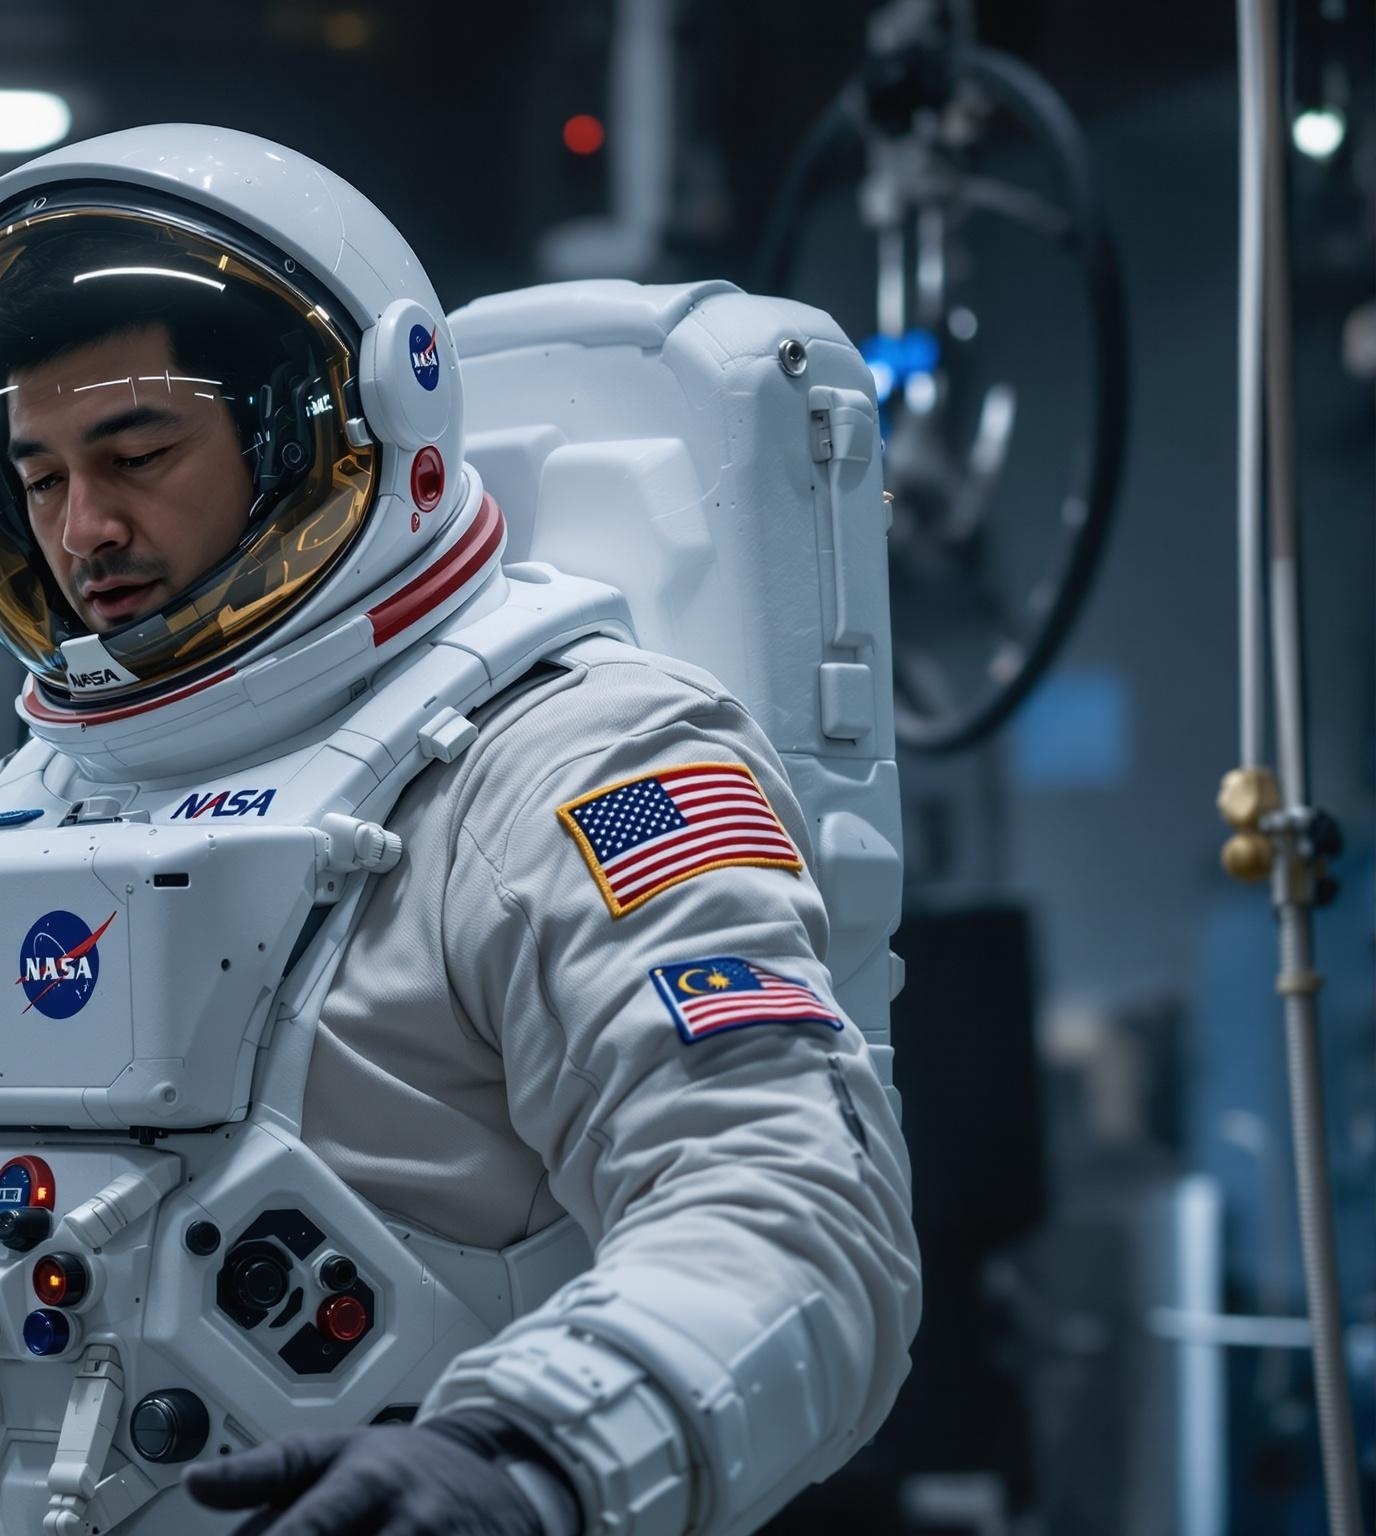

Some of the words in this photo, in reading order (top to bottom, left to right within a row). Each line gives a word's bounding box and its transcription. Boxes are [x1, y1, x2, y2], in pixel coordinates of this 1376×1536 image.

[69, 668, 121, 688] NASA
[170, 788, 277, 820] NASA
[26, 956, 93, 981] NASA
